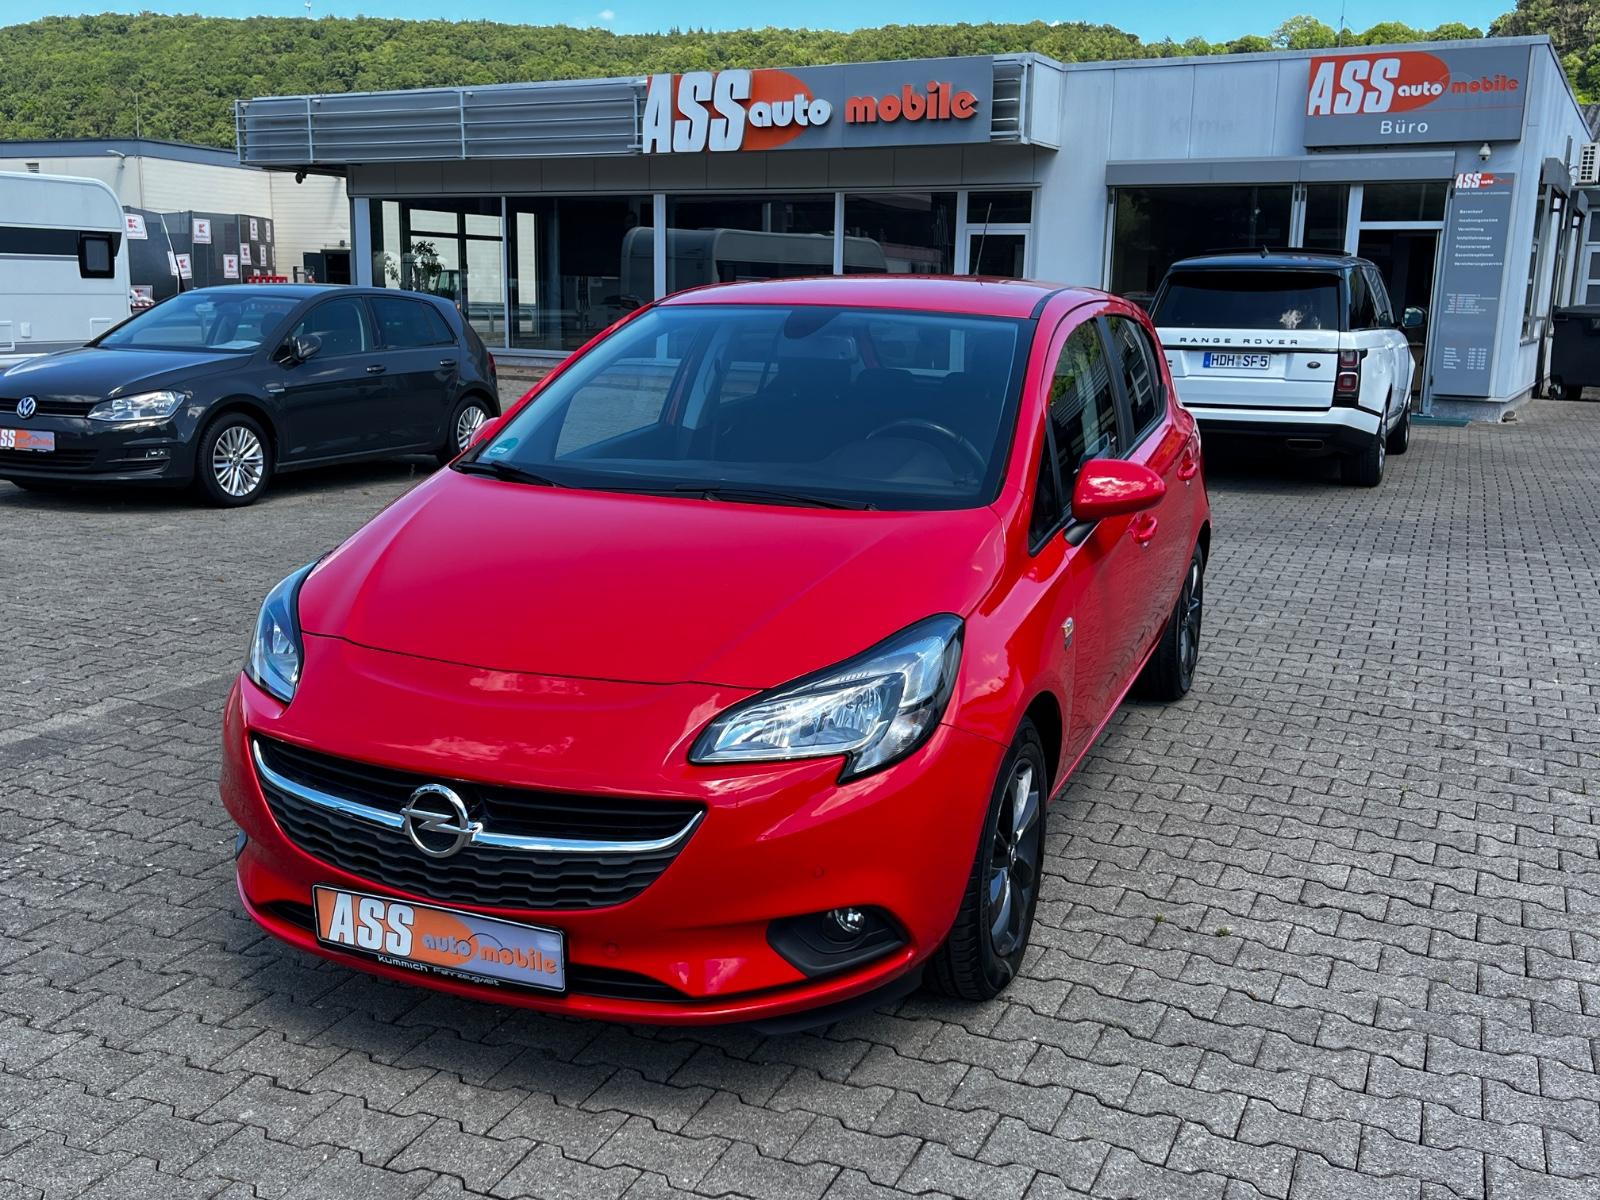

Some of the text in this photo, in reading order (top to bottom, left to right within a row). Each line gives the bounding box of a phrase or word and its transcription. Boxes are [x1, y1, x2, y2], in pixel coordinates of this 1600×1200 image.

[1307, 58, 1520, 116] ASS auto mobile
[642, 69, 978, 154] ASS auto mobile
[1380, 119, 1429, 135] Büro
[1455, 173, 1482, 189] ASS
[1211, 354, 1235, 366] HDH
[0, 429, 16, 447] SS
[328, 892, 558, 974] ASS auto mobile
